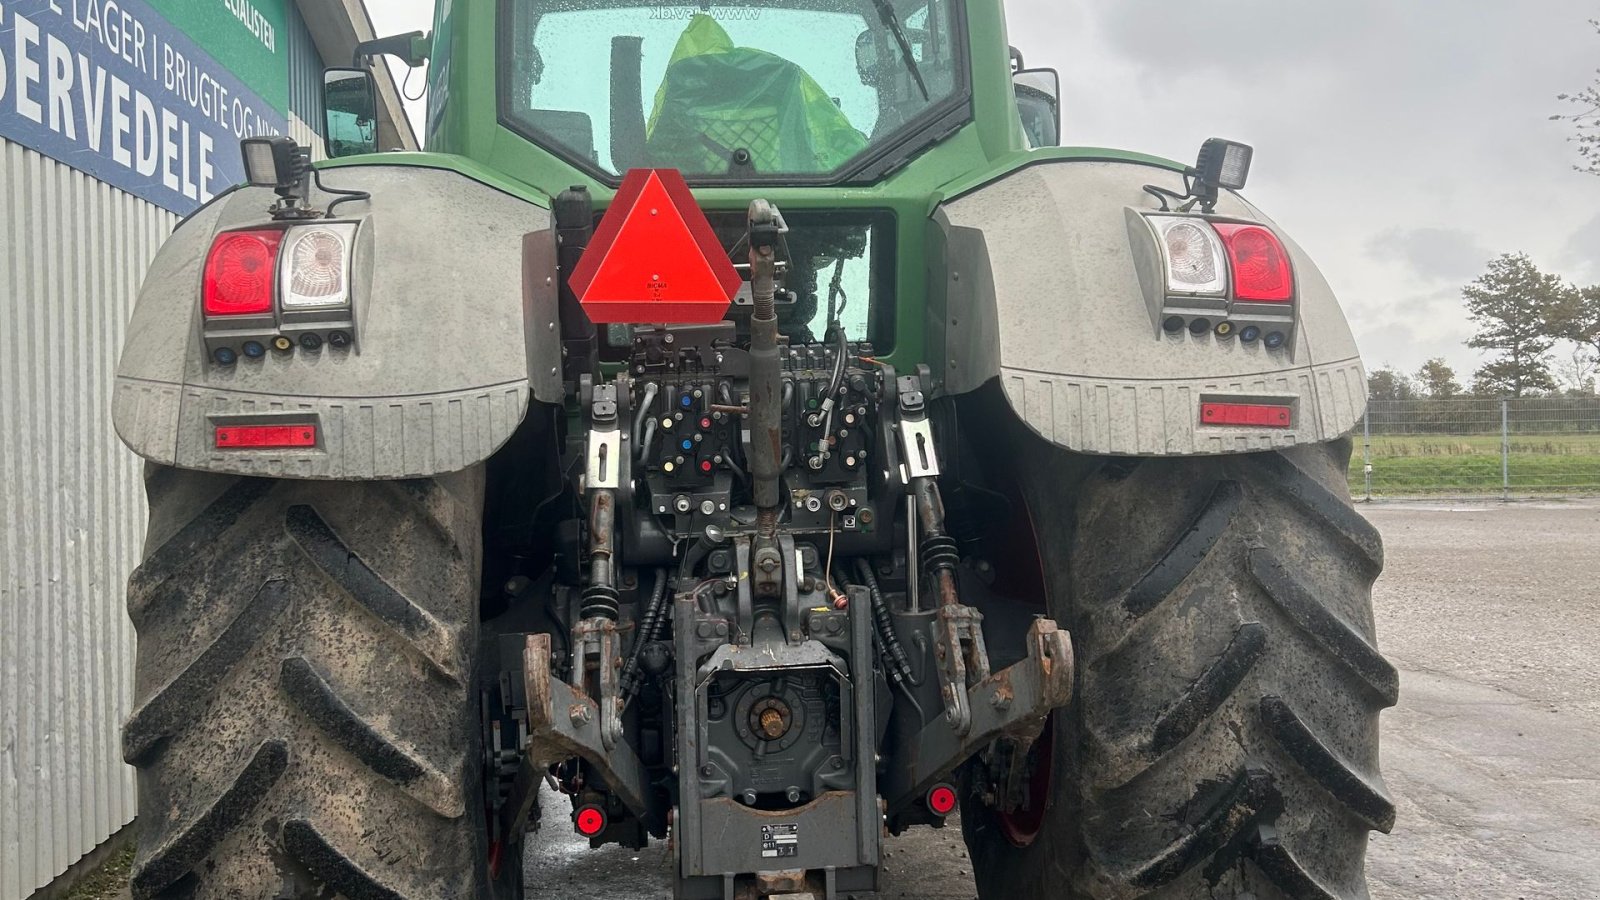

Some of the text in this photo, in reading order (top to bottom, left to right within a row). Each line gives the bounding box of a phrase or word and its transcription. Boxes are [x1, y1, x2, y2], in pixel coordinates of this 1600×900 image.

[0, 3, 214, 205] ERVEDELE
[73, 0, 147, 74] LAGER
[153, 34, 158, 81] I
[164, 43, 228, 130] BRUGTE
[232, 98, 253, 139] OG
